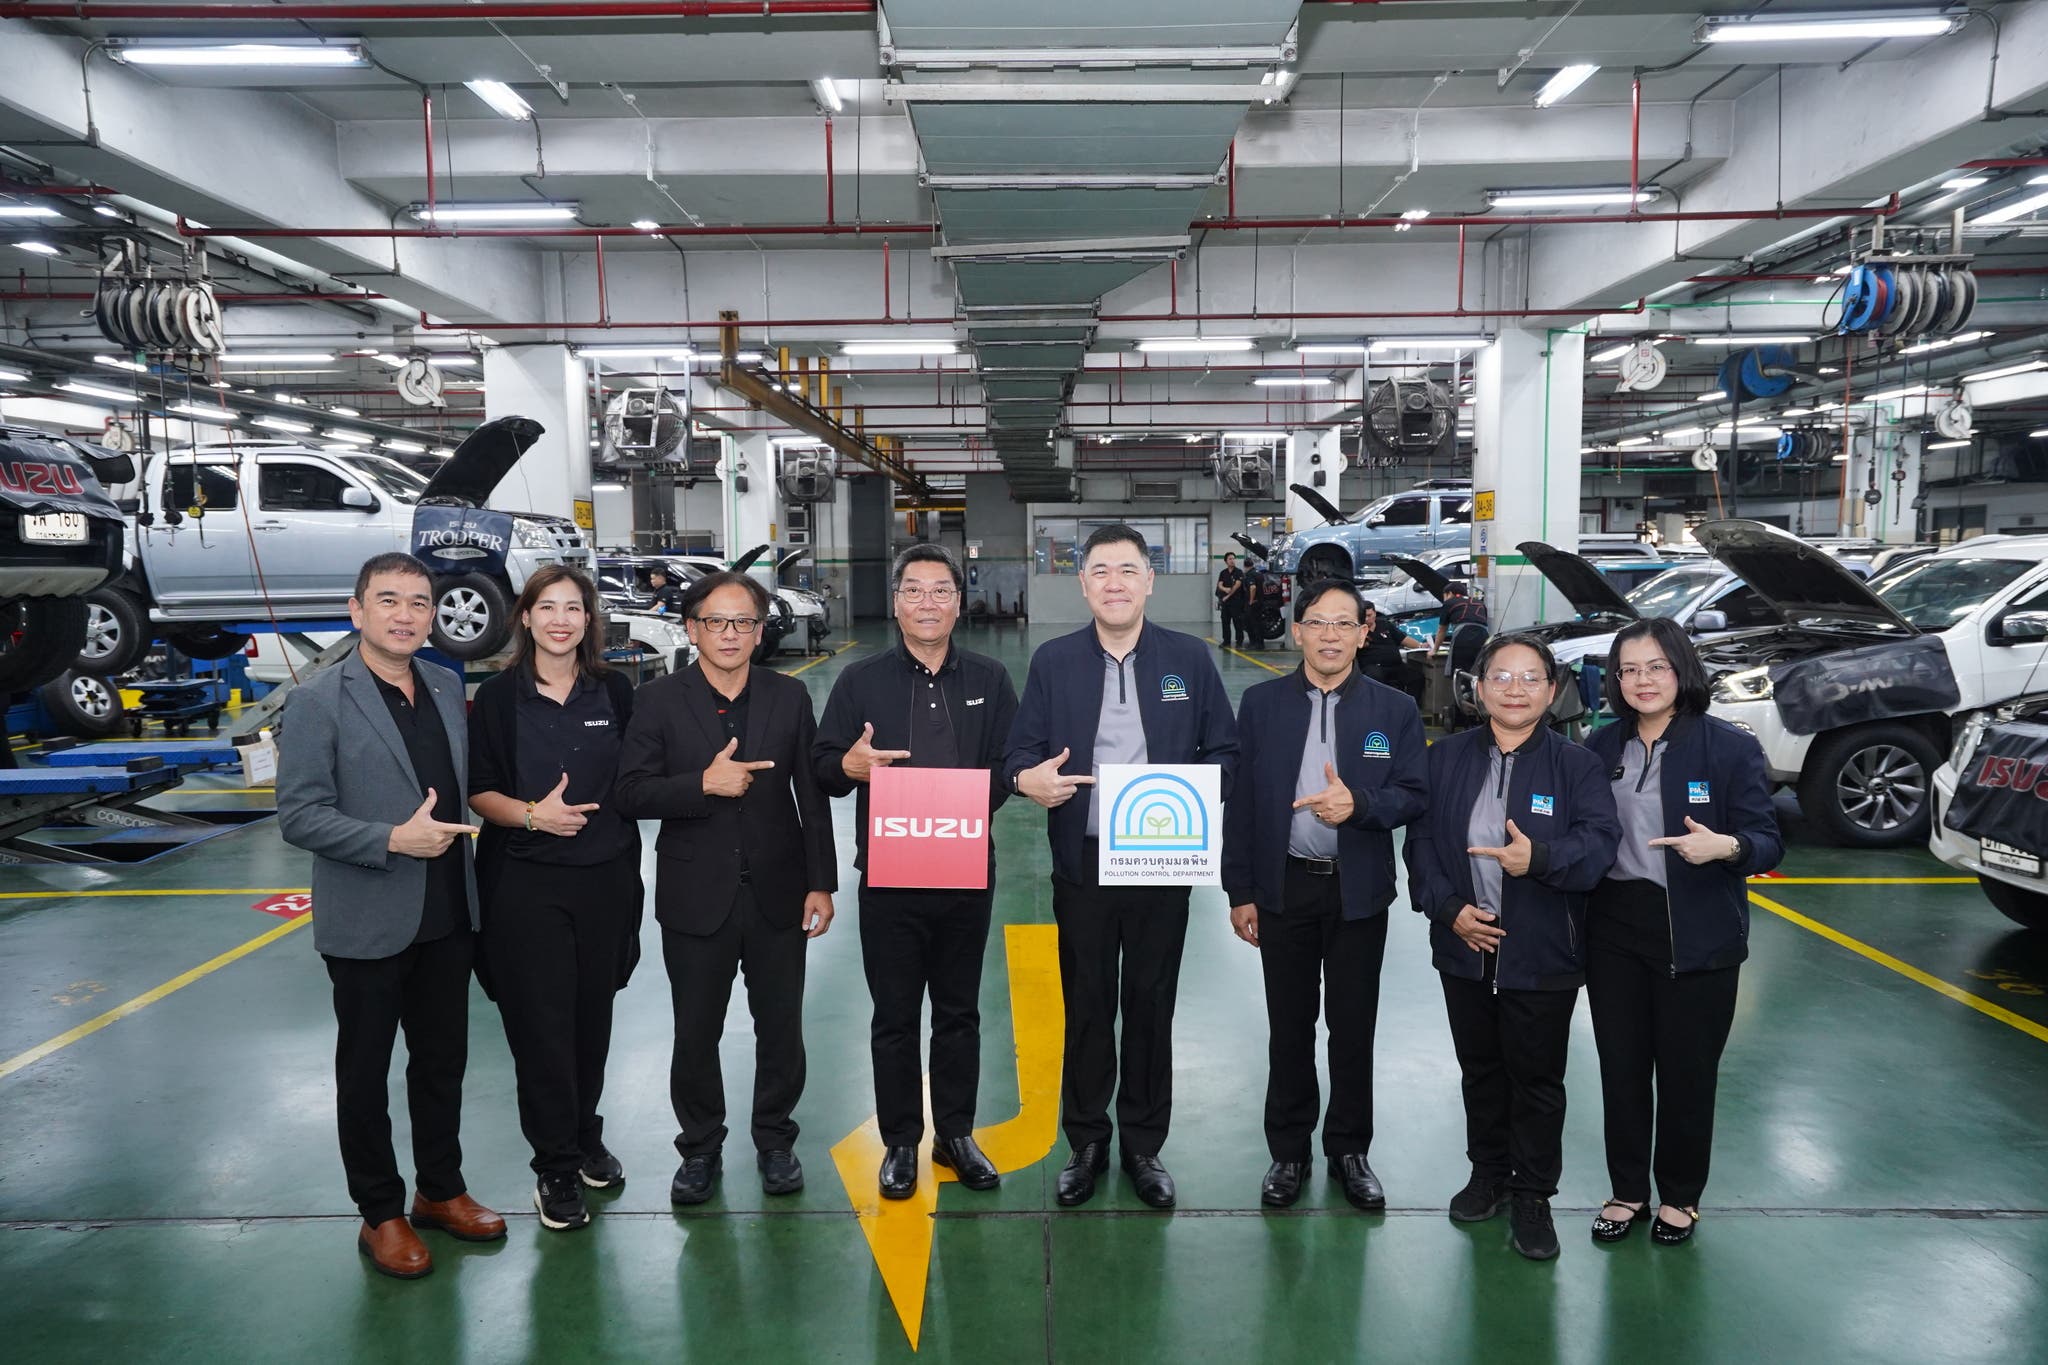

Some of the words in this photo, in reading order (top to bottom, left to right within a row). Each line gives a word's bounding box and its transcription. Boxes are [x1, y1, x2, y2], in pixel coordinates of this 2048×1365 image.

[418, 530, 503, 551] TROOPER
[584, 719, 609, 727] ISUZU
[874, 816, 983, 839] ISUZU
[1110, 854, 1208, 869] กรมควบคุมมลพิษ
